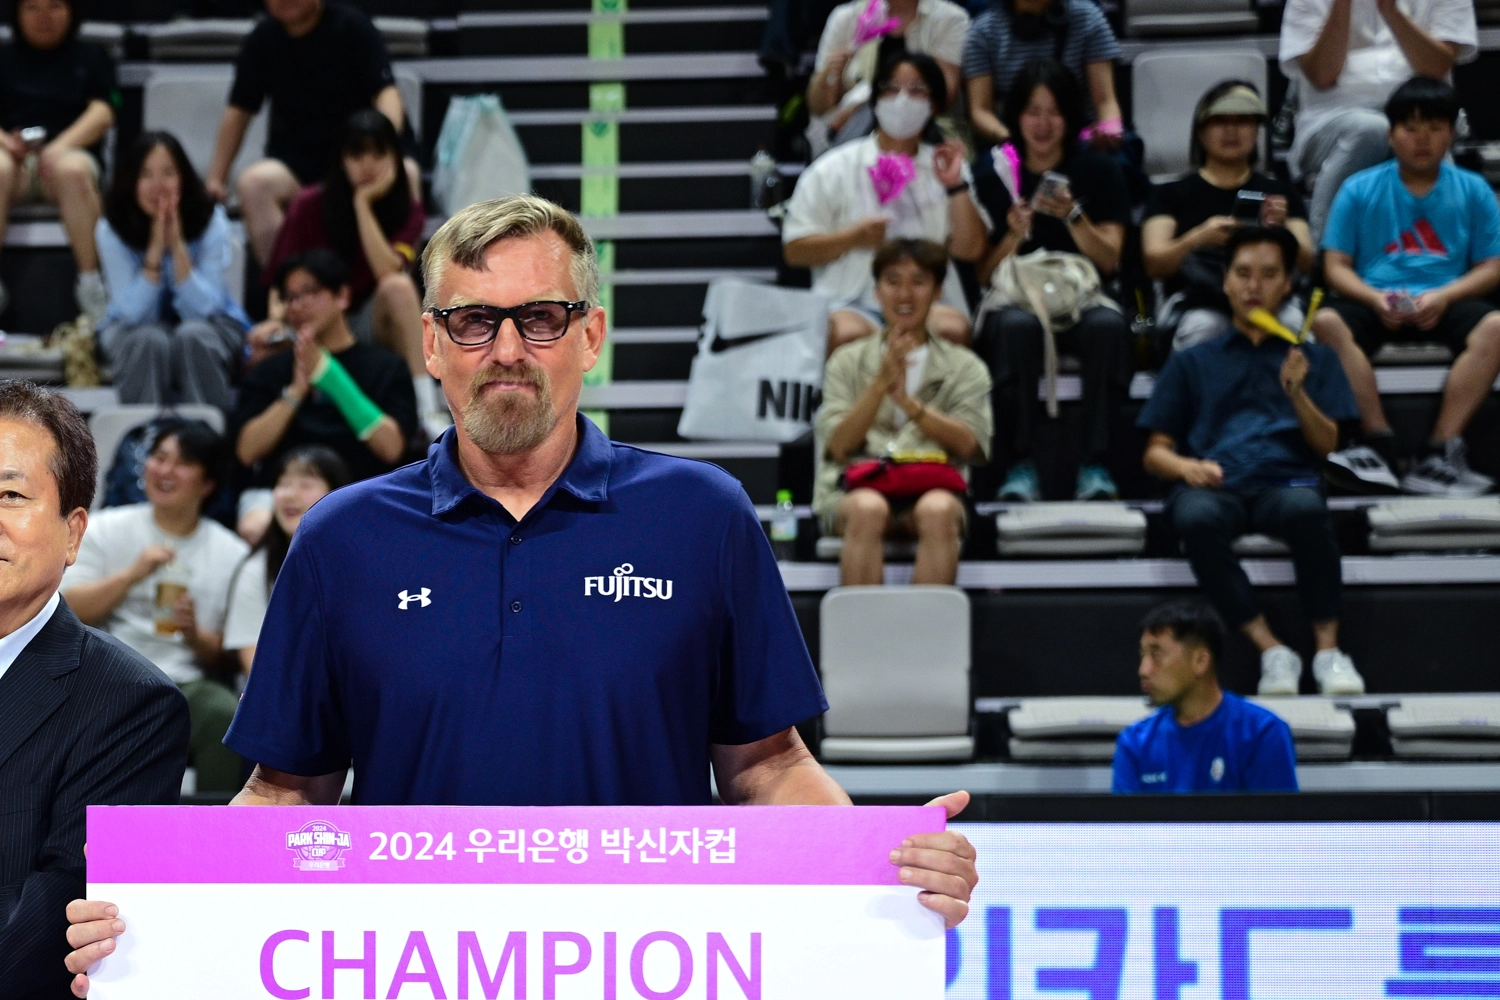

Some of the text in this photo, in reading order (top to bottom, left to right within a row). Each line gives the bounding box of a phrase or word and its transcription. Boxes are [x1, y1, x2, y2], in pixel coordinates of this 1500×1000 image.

[758, 379, 823, 422] NIK
[584, 563, 673, 602] FUJITSU
[287, 832, 313, 847] PARK
[368, 828, 737, 865] 2024 우리은행 박신자컵
